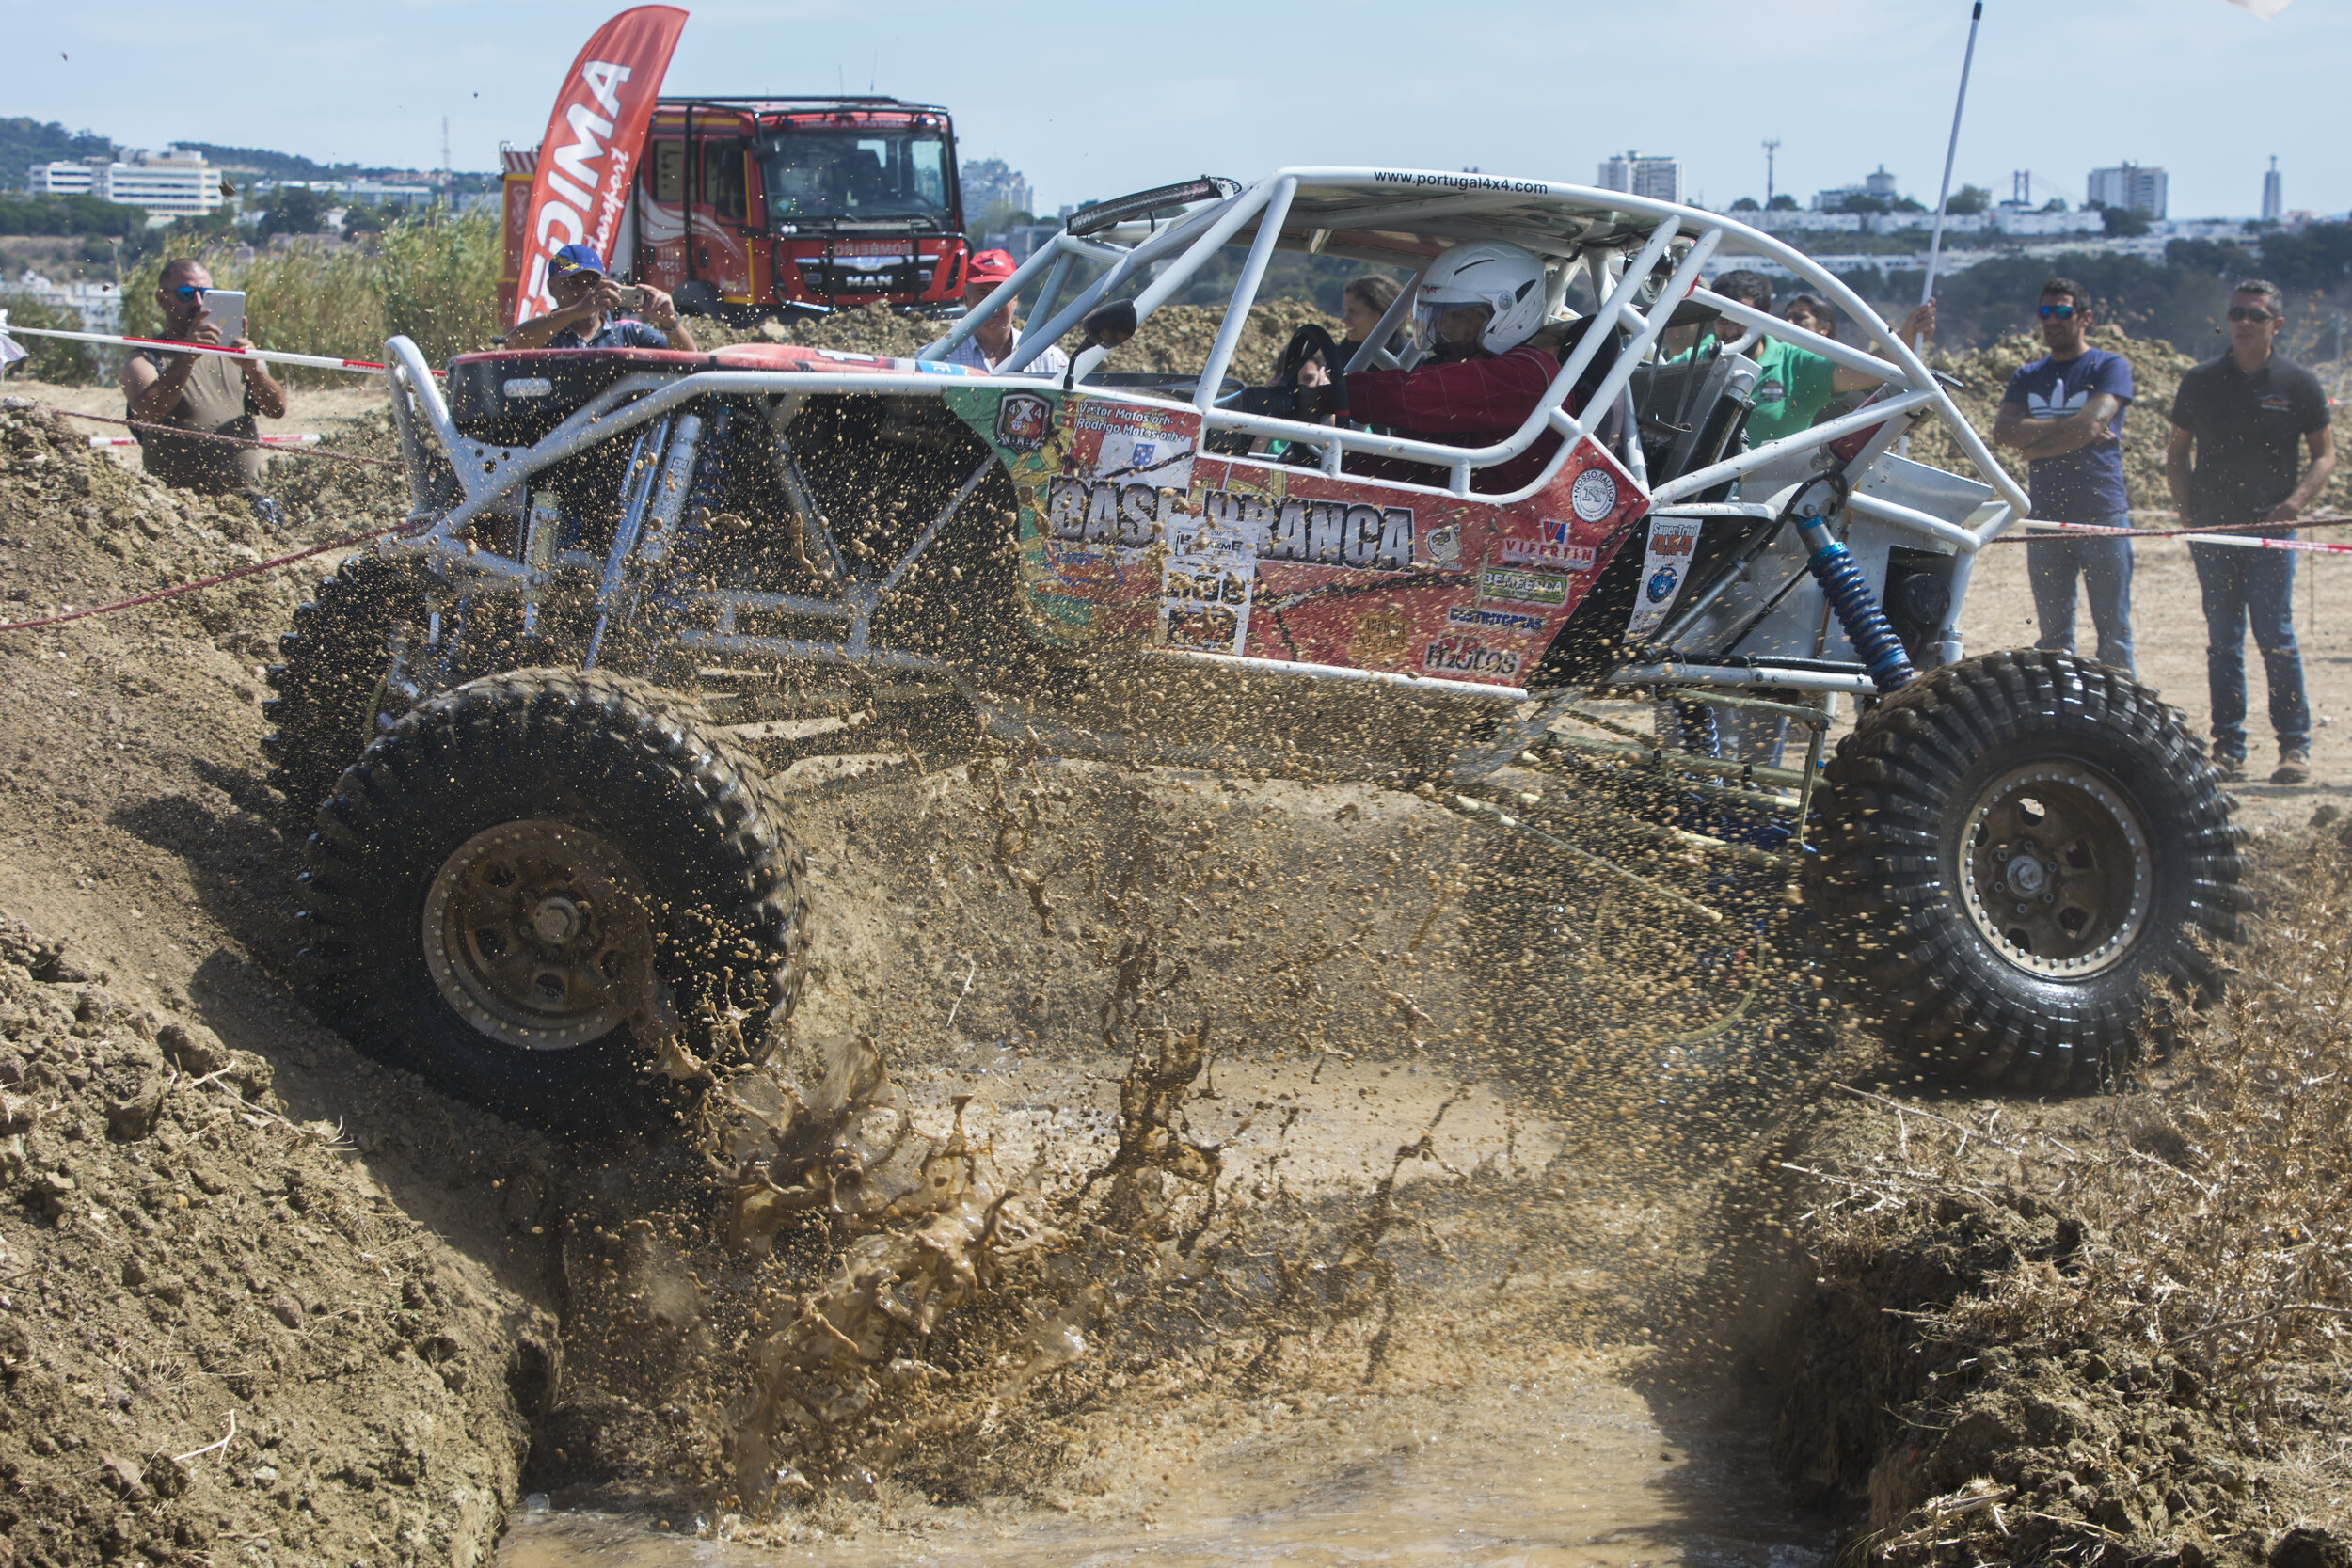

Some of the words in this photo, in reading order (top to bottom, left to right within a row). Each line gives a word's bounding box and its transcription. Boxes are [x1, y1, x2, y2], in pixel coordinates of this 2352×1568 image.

[1374, 170, 1549, 195] www.portugal4x4.com
[585, 146, 630, 262] torsport
[846, 274, 893, 287] MAN
[1115, 407, 1150, 423] Matos
[1076, 416, 1120, 435] Rodrigo
[1122, 423, 1158, 439] Matos
[1573, 470, 1598, 494] NOSSO
